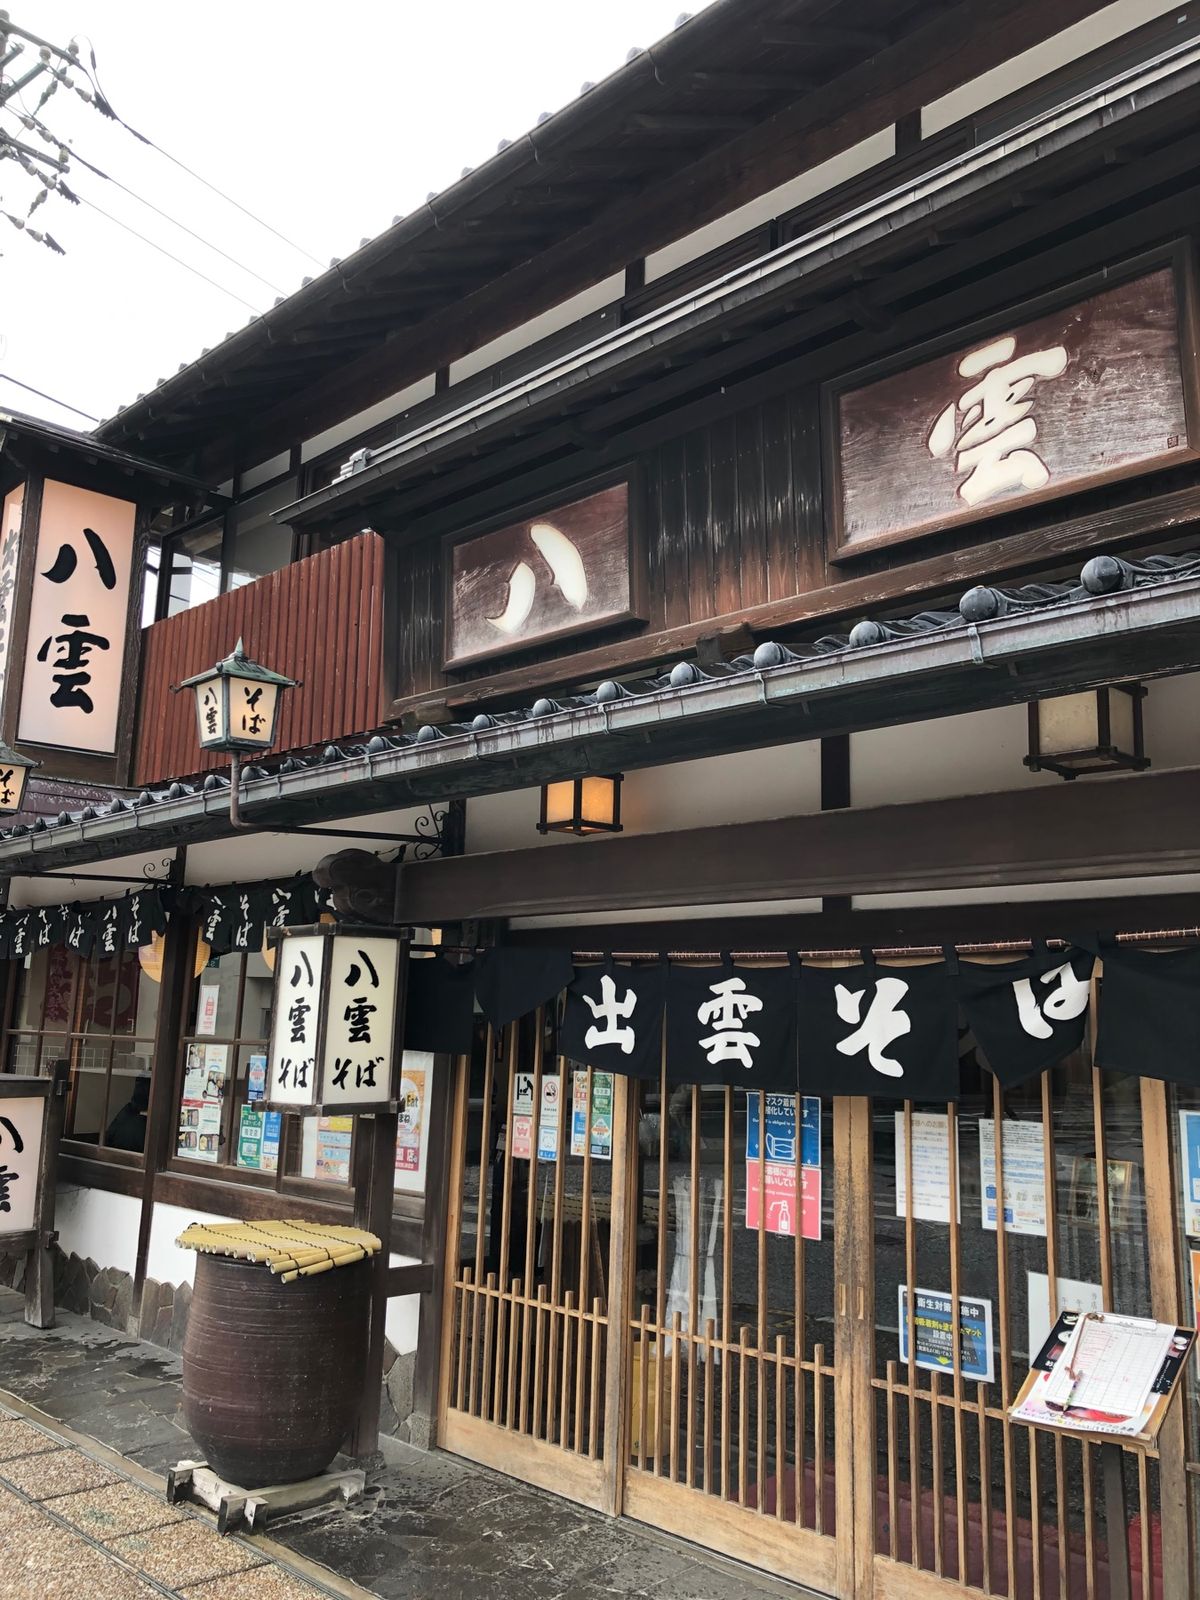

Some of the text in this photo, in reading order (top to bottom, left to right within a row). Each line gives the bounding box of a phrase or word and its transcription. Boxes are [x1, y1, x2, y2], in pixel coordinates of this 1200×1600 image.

[927, 336, 1068, 508] 雲
[485, 522, 588, 634] 八
[37, 527, 117, 714] 八雲
[204, 687, 218, 734] 八雲
[242, 686, 267, 735] そば
[102, 904, 118, 952] 八雲
[128, 895, 142, 943] そば
[236, 894, 254, 947] そば
[278, 950, 316, 1090] 八雲 そば
[343, 949, 380, 1044] 八雲
[331, 1056, 385, 1091] そば
[917, 1297, 980, 1318] 衛生対策施中
